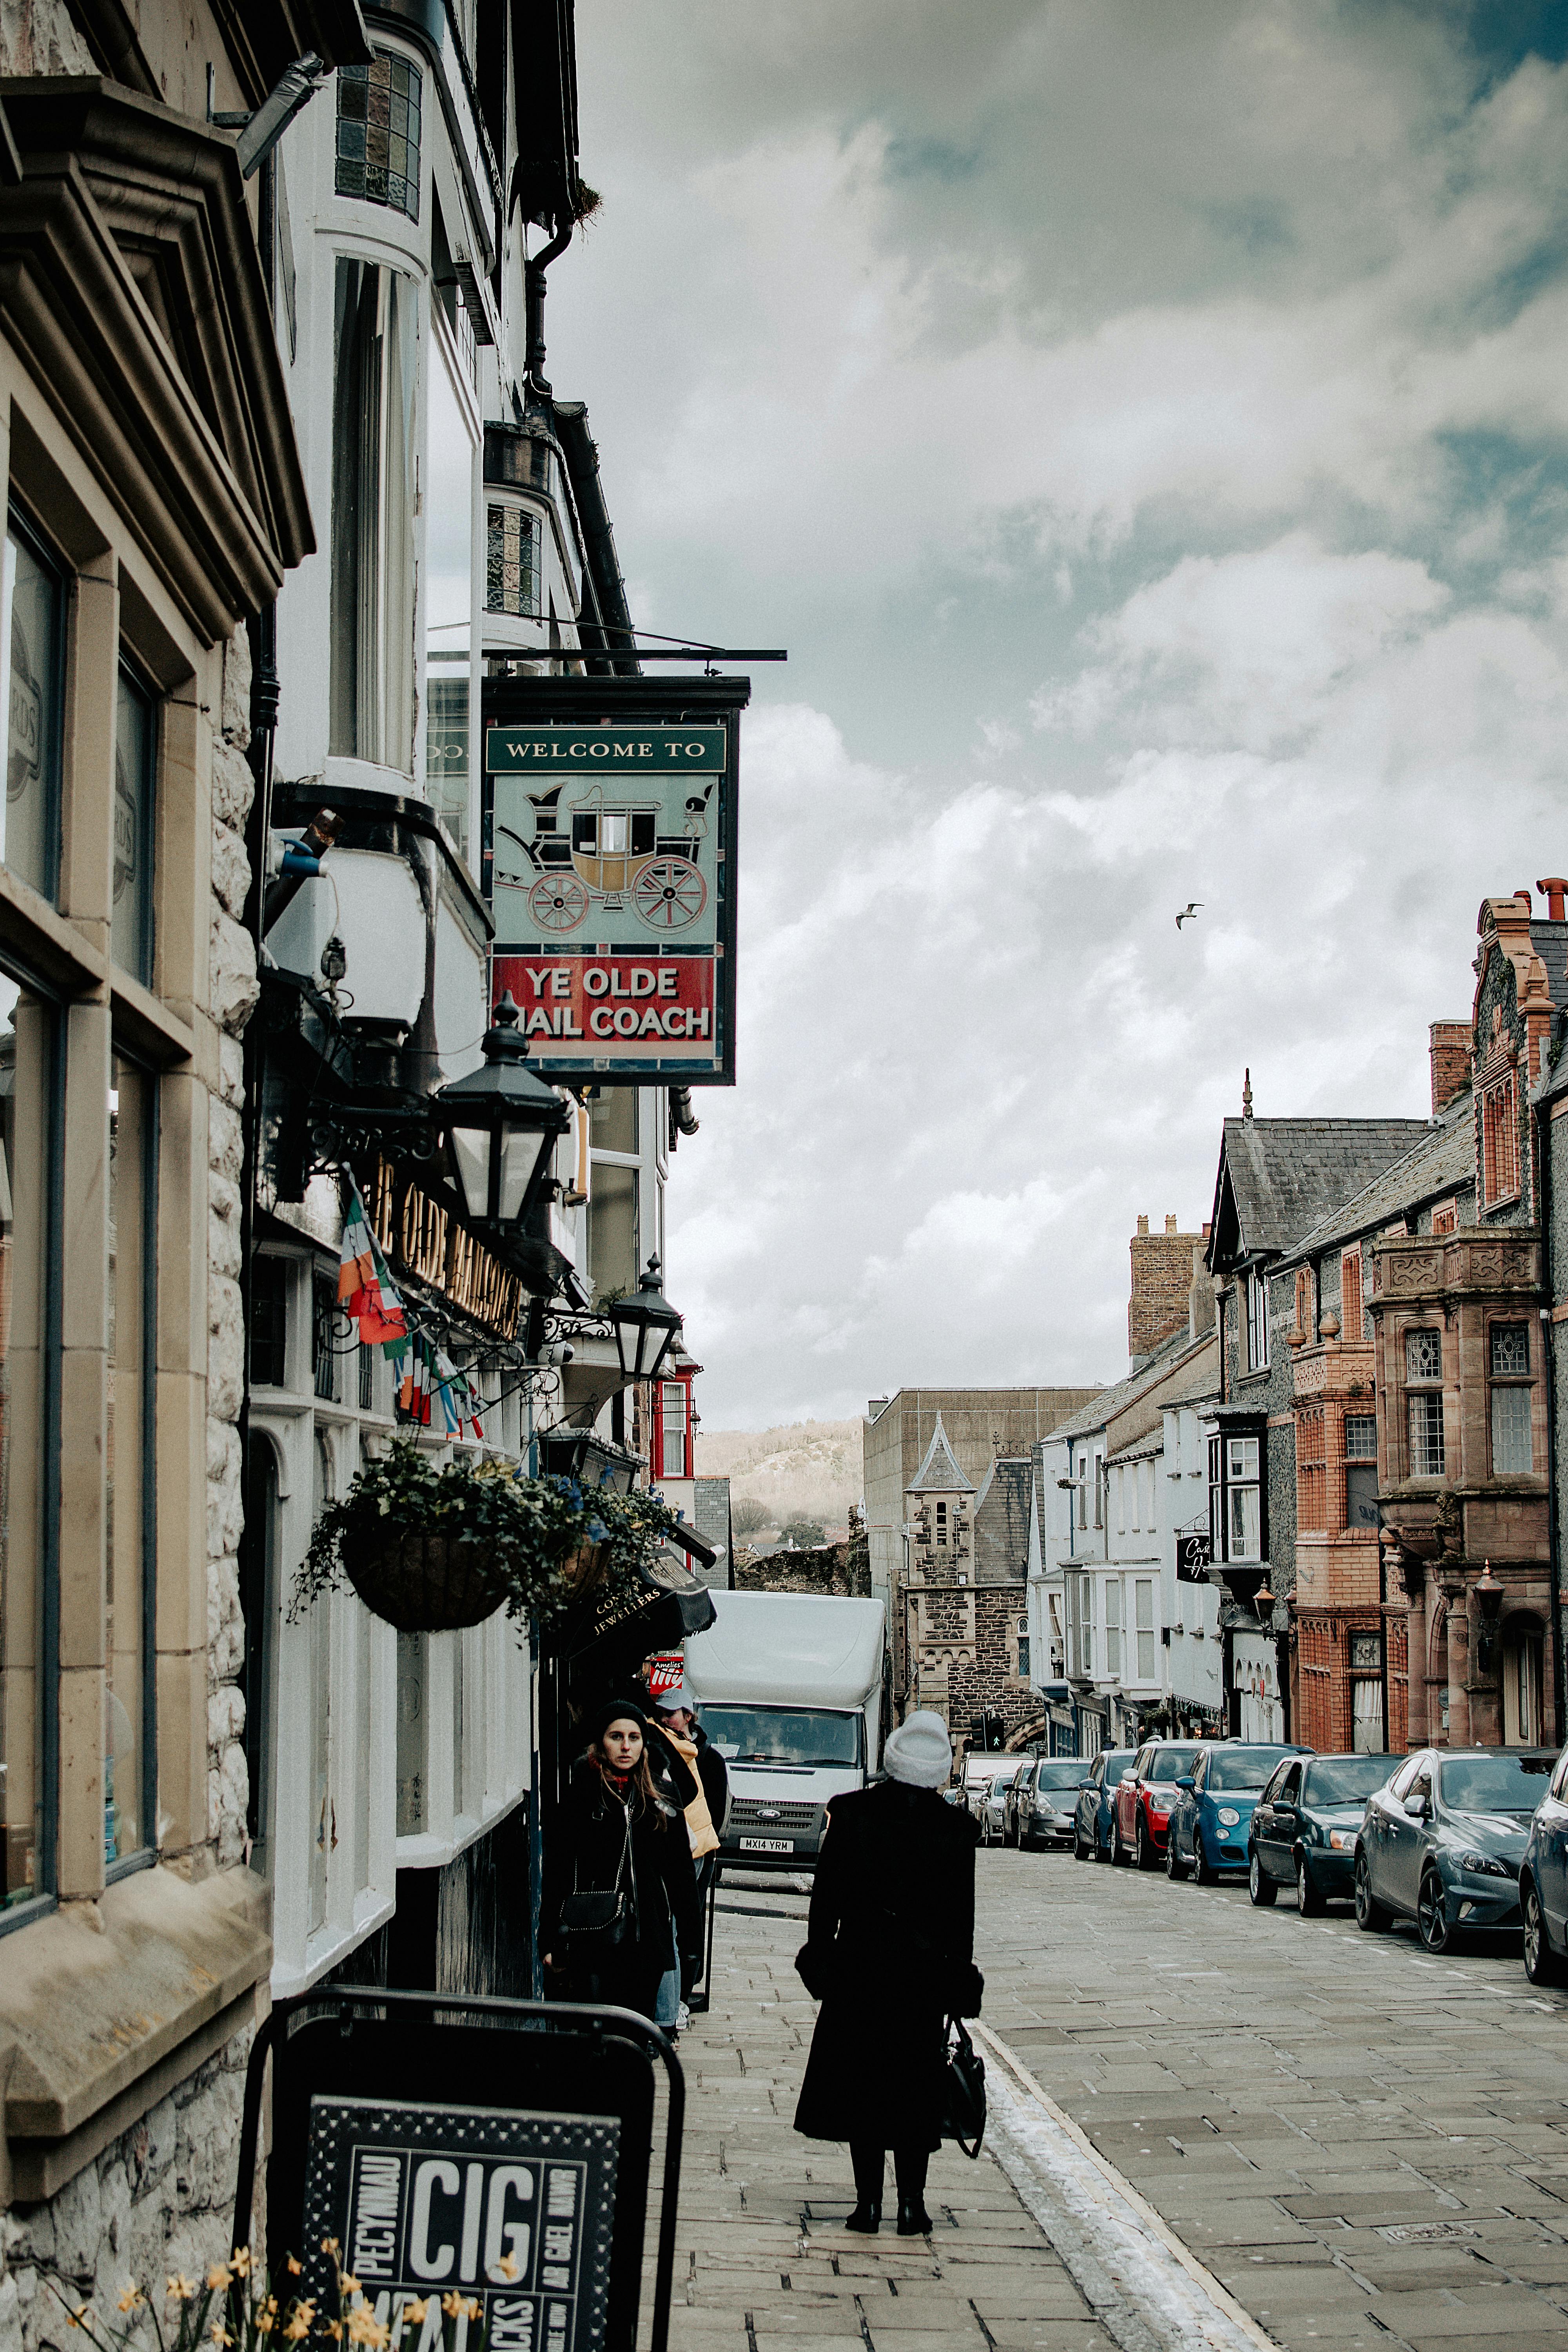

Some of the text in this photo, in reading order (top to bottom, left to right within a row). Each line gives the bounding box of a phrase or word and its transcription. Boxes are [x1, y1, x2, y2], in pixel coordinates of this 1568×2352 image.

[506, 743, 705, 757] WELCOME TO
[525, 967, 677, 996] YE OLDE
[590, 1006, 709, 1036] COACH
[402, 1182, 448, 1291] OLDE
[746, 1839, 788, 1850] MX14 YRM
[354, 2155, 401, 2276] PECYNNAU
[410, 2160, 534, 2285] CIG
[542, 2168, 577, 2289] AR GAEL NAWR
[490, 2298, 534, 2352] CKS
[549, 2302, 567, 2328] NOW
